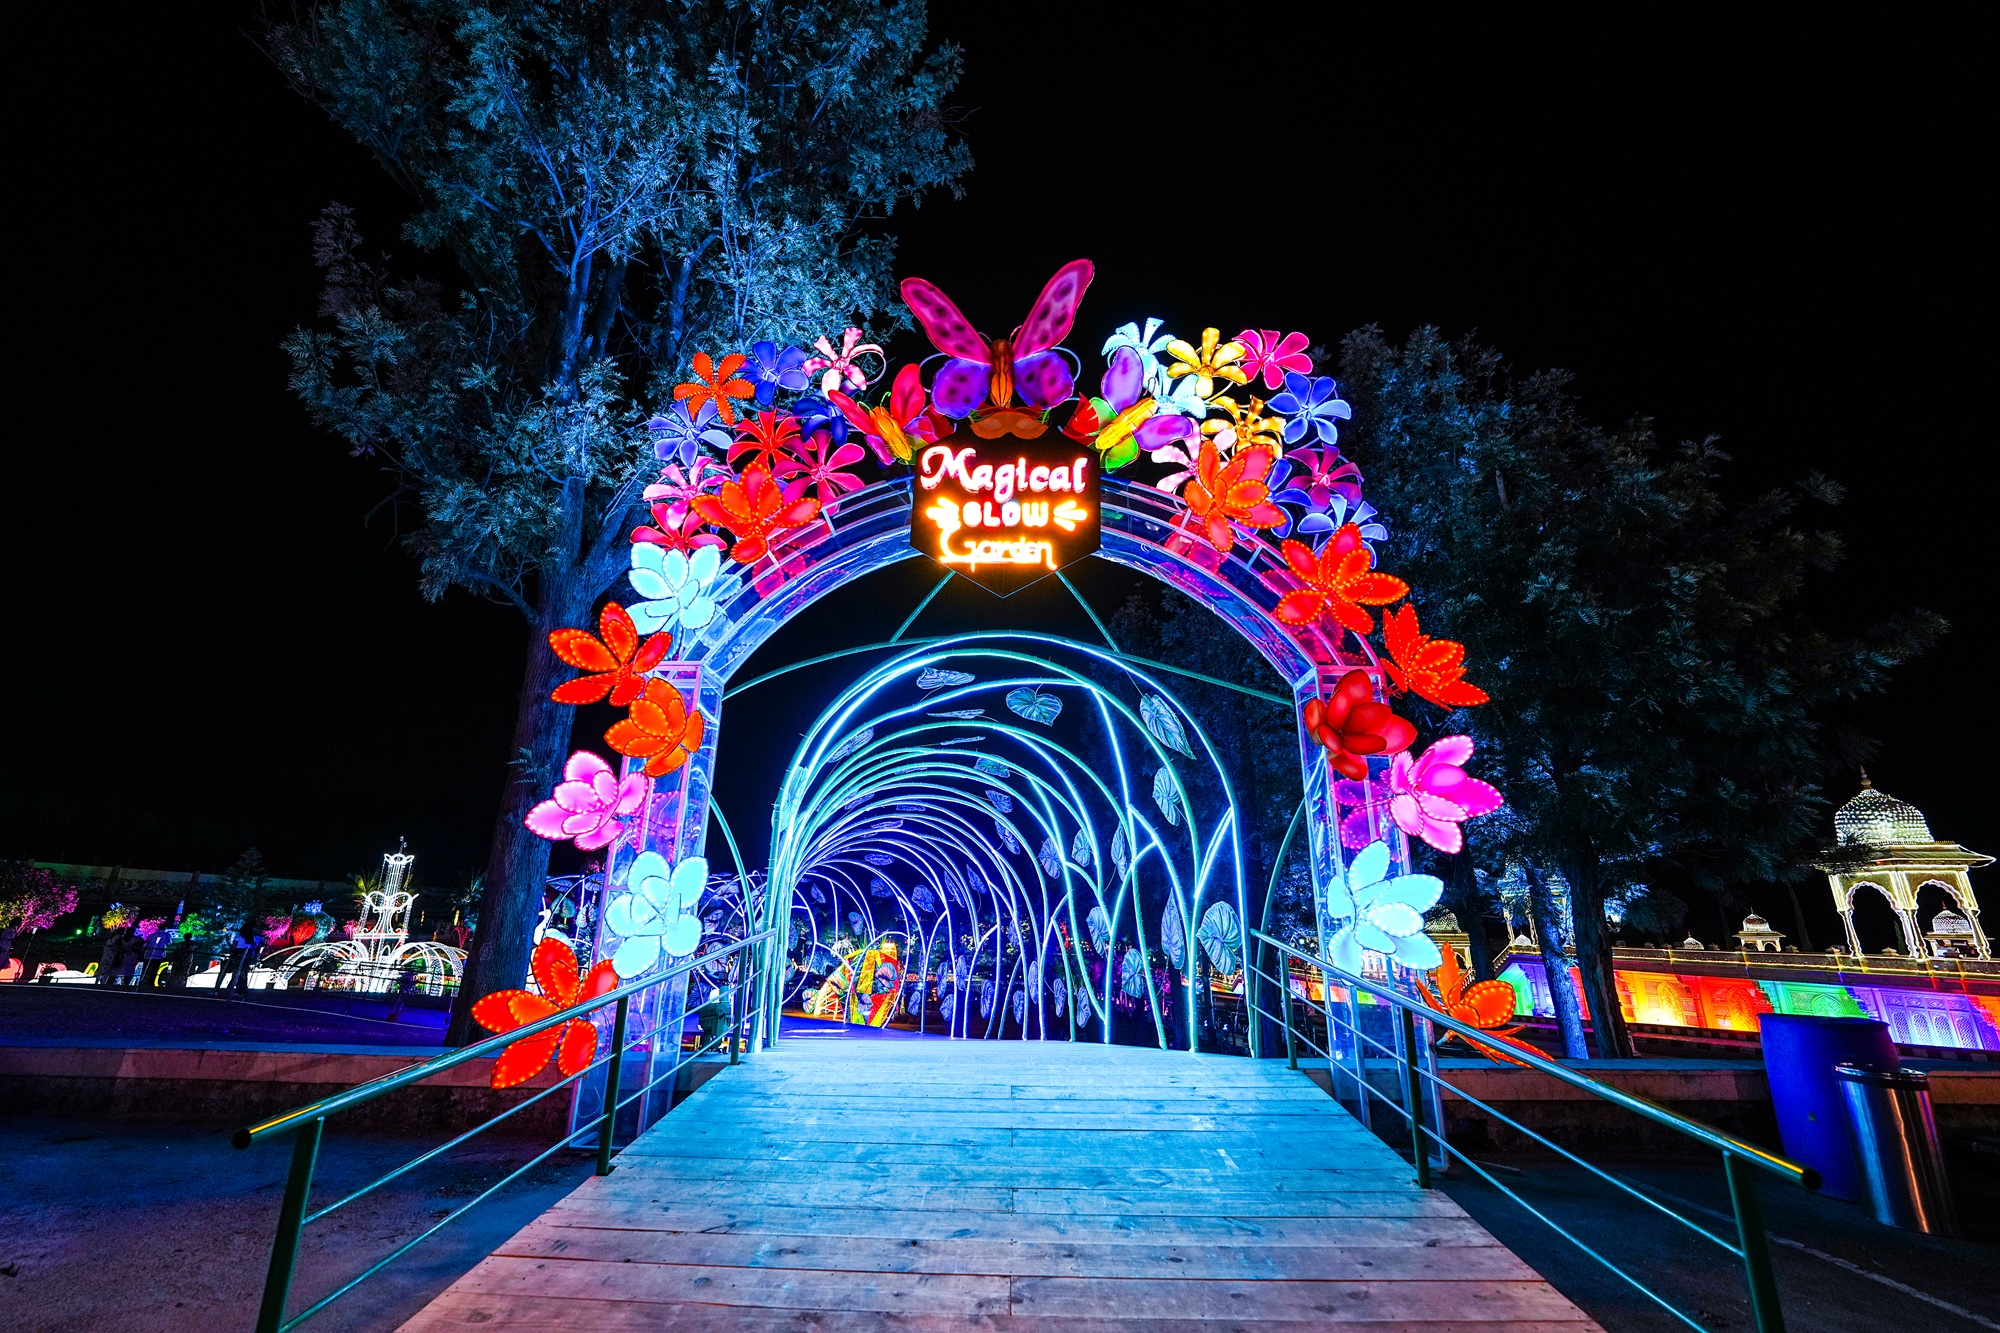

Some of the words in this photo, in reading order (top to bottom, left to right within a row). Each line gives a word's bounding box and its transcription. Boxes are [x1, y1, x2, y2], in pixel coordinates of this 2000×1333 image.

[920, 445, 1088, 503] Magical
[962, 501, 1049, 528] GLOW
[939, 527, 1058, 572] Garden
